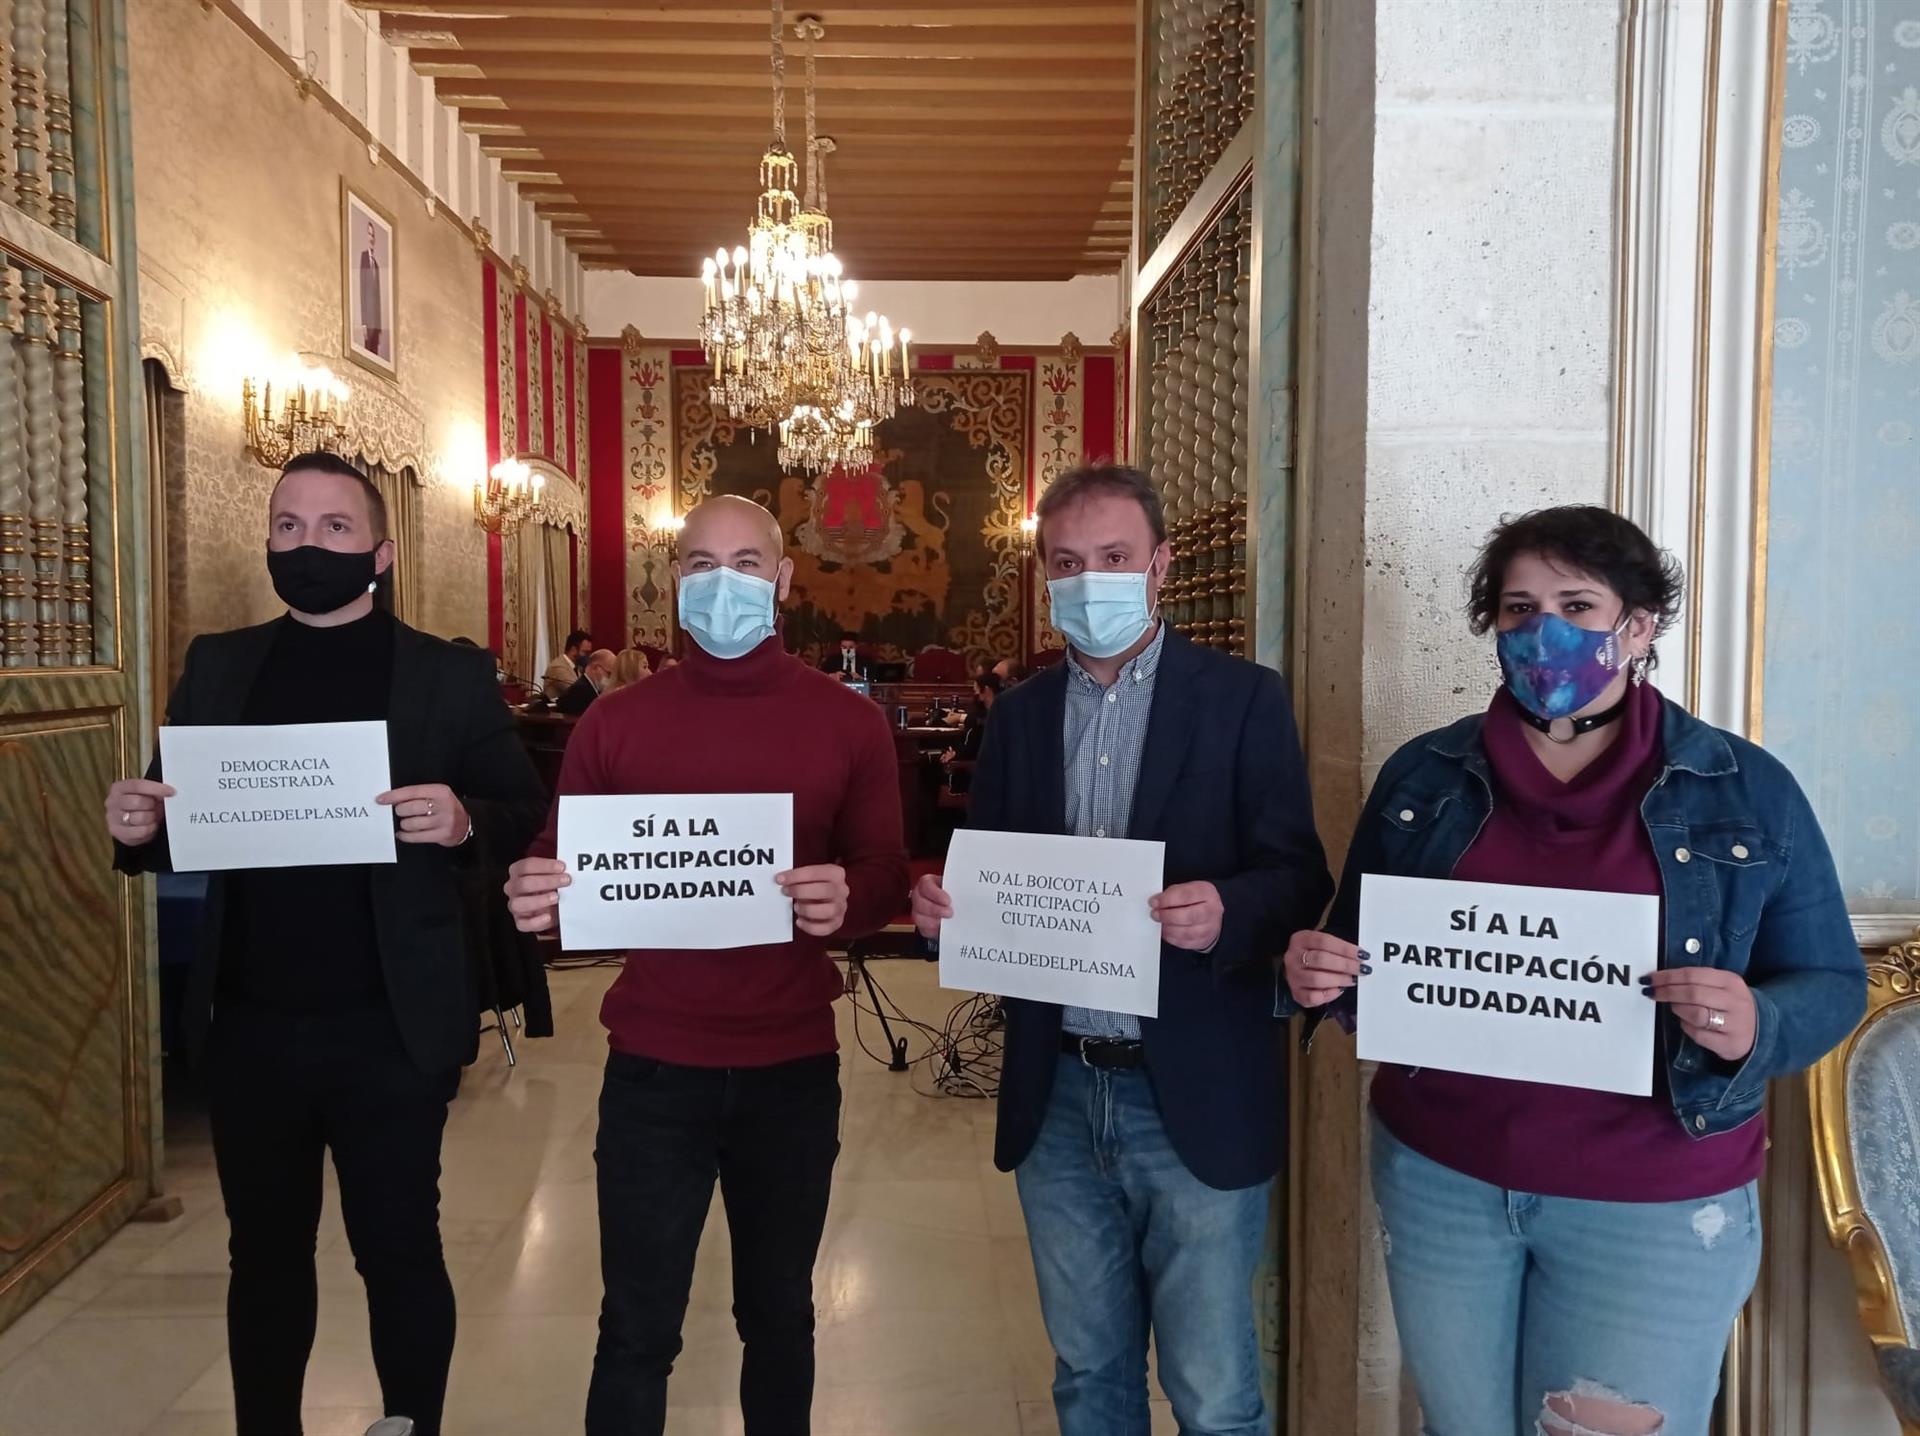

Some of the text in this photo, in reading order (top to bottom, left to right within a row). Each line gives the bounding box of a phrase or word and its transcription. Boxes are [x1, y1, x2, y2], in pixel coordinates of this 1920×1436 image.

[220, 757, 331, 774] DEMOCRACIA
[217, 774, 335, 790] SECUESTRADA
[189, 806, 370, 825] #ALCALDEDELPLASMA
[631, 813, 720, 838] SÍ A LA
[577, 843, 775, 872] PARTICIPACIÓN
[599, 878, 755, 902] CIUDADANA
[978, 869, 1124, 897] NO AL BOICOT A LA
[996, 890, 1101, 915] PARTICIPACIÓ
[1001, 910, 1093, 935] CIUTADANA
[1449, 904, 1560, 941] SÍ A LA
[960, 944, 1137, 979] #ALCALDEDELPLASMA
[1383, 941, 1631, 987] PARTICIPACIÓN
[1406, 981, 1603, 1024] CIUDADANA
